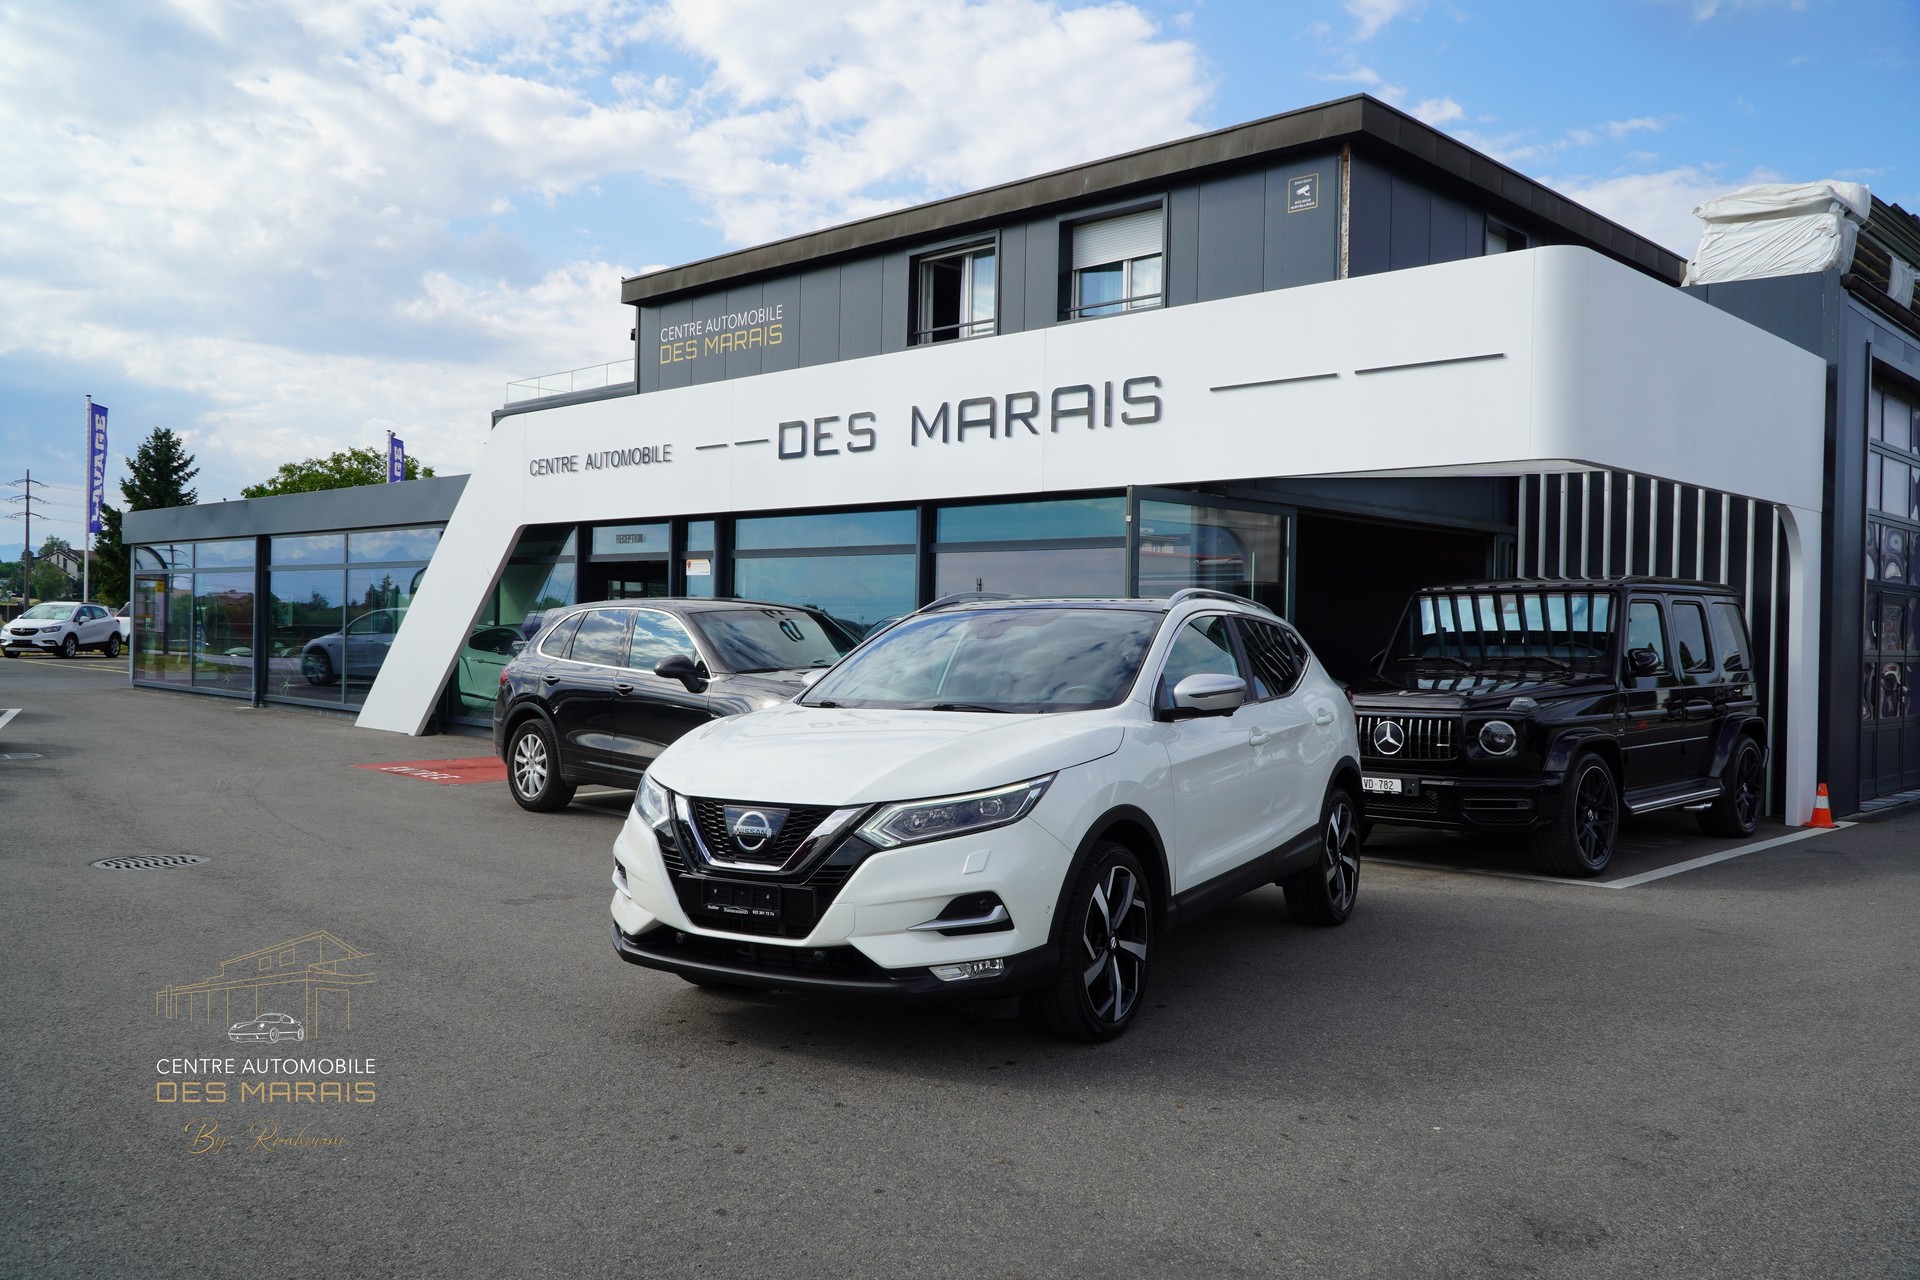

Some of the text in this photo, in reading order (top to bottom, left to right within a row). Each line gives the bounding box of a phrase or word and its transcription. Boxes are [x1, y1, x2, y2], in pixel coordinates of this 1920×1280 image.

[659, 323, 783, 365] DES MARAIS
[660, 304, 783, 342] CENTRE AUTOMOBILE
[529, 375, 1163, 477] CENTRE AUTOMOBILE DES MARAIS
[90, 413, 106, 523] LAVAGE
[735, 827, 768, 836] NISSAN
